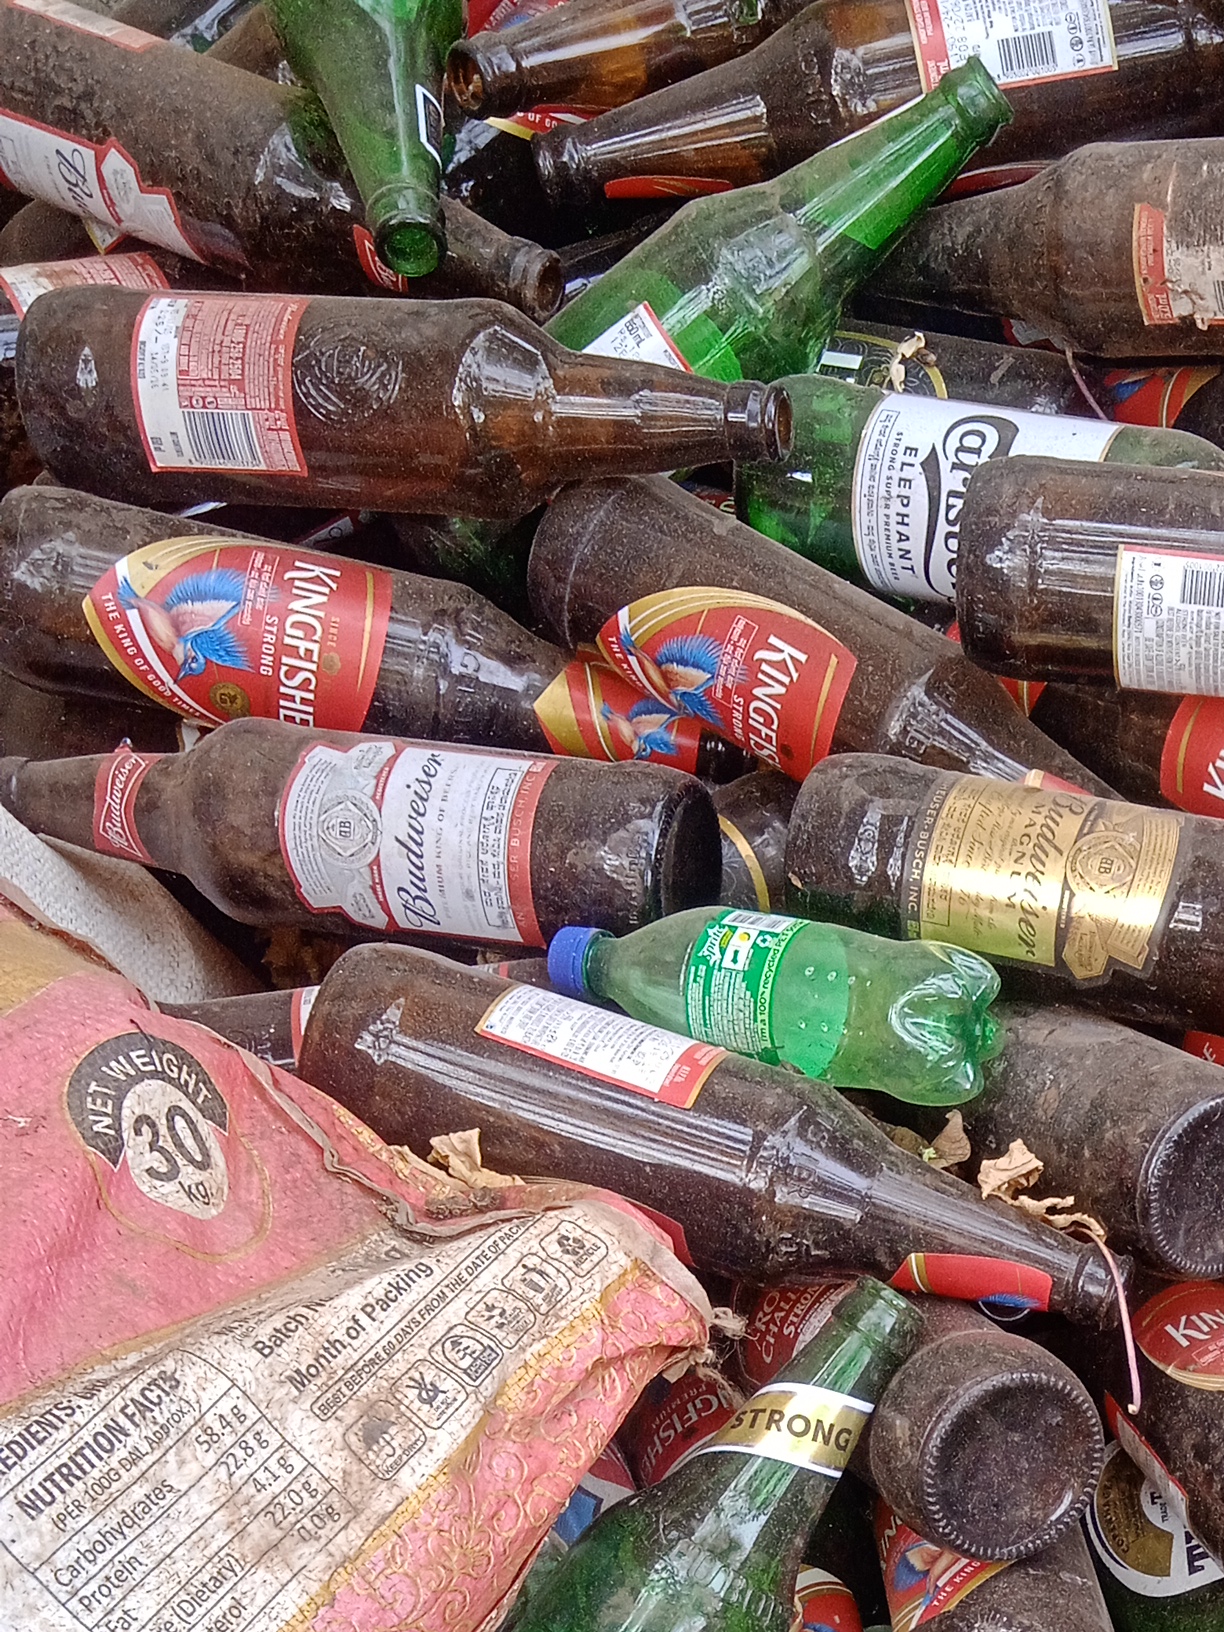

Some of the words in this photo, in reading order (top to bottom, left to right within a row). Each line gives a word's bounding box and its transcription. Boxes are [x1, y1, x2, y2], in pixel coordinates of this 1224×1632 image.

[885, 431, 903, 471] STRONG
[882, 513, 893, 558] PREMIUM
[894, 446, 918, 573] ELEPHANT
[887, 562, 900, 580] BEER
[101, 592, 118, 620] THE
[112, 624, 136, 655] KING
[129, 657, 147, 672] OF
[144, 673, 169, 697] GOOD
[259, 614, 280, 676] STRONG
[103, 755, 136, 845] Budweiser
[385, 749, 457, 929] Budweiser
[908, 782, 948, 882] HEUSER-BUSCH,
[906, 885, 920, 914] INC.
[1010, 789, 1088, 961] Budweiser
[758, 948, 779, 989] recycled
[86, 1083, 116, 1134] NET
[101, 1052, 211, 1104] WEIGHT
[136, 1103, 209, 1183] 30
[253, 1306, 311, 1360] Batch
[287, 1333, 347, 1392] Month
[338, 1314, 367, 1345] of
[362, 1256, 436, 1325] Packing
[317, 1385, 348, 1417] BEST
[343, 1352, 386, 1392] BEFORE
[393, 1316, 423, 1345] DAYS
[418, 1290, 449, 1321] FROM
[445, 1271, 468, 1295] THE
[464, 1250, 491, 1277] DATE
[487, 1239, 503, 1256] OF
[15, 1417, 131, 1521] NUTRITION
[729, 1403, 852, 1454] STRONG
[51, 1493, 90, 1533] (PER
[79, 1462, 120, 1503] 100G
[115, 1439, 148, 1472] DAL
[51, 1476, 178, 1590] Carbohydrates
[193, 1411, 235, 1454] 58.4
[229, 1402, 248, 1424] g
[250, 1465, 279, 1495] 4.1
[277, 1453, 295, 1475] g
[77, 1550, 144, 1614] Protein
[170, 1551, 247, 1626] (Dietary)
[264, 1487, 305, 1527] 22.0
[930, 1579, 958, 1606] THE
[955, 1558, 981, 1582] KING
